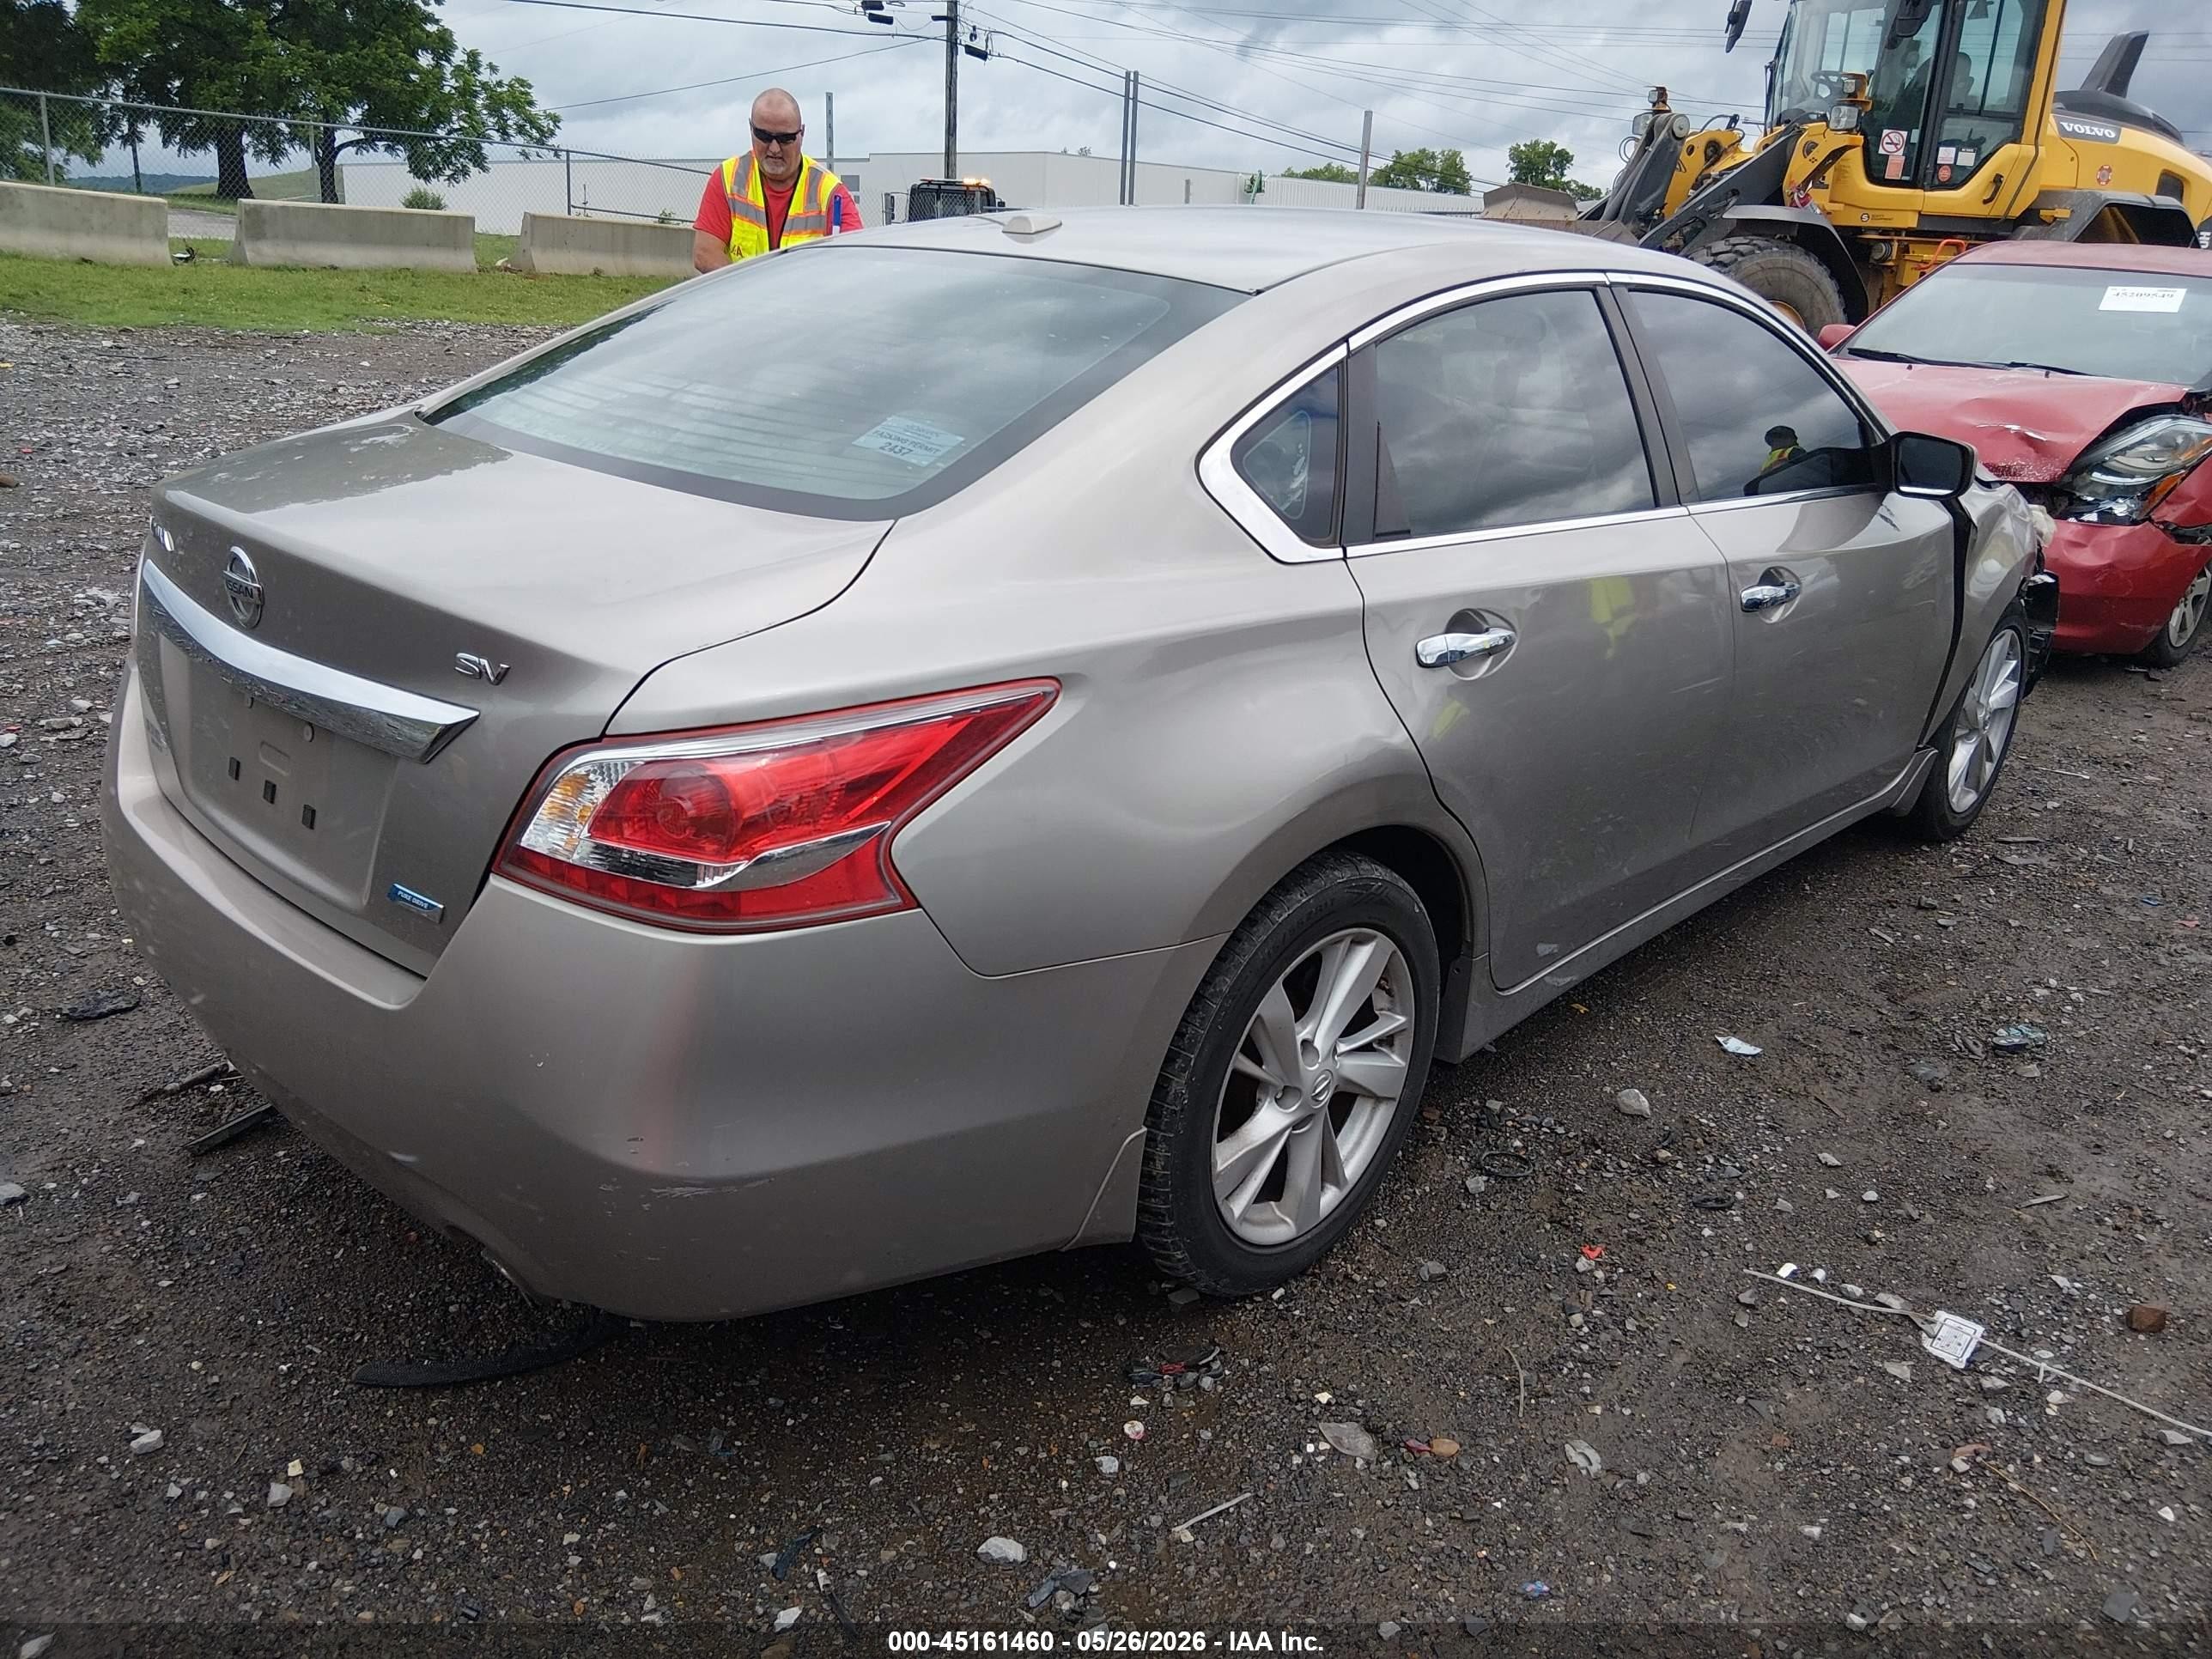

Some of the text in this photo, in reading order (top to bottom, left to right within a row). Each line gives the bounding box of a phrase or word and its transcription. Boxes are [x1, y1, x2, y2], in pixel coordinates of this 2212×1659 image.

[2060, 121, 2116, 138] VOLVO
[226, 580, 255, 599] SSAN
[454, 652, 511, 685] SV
